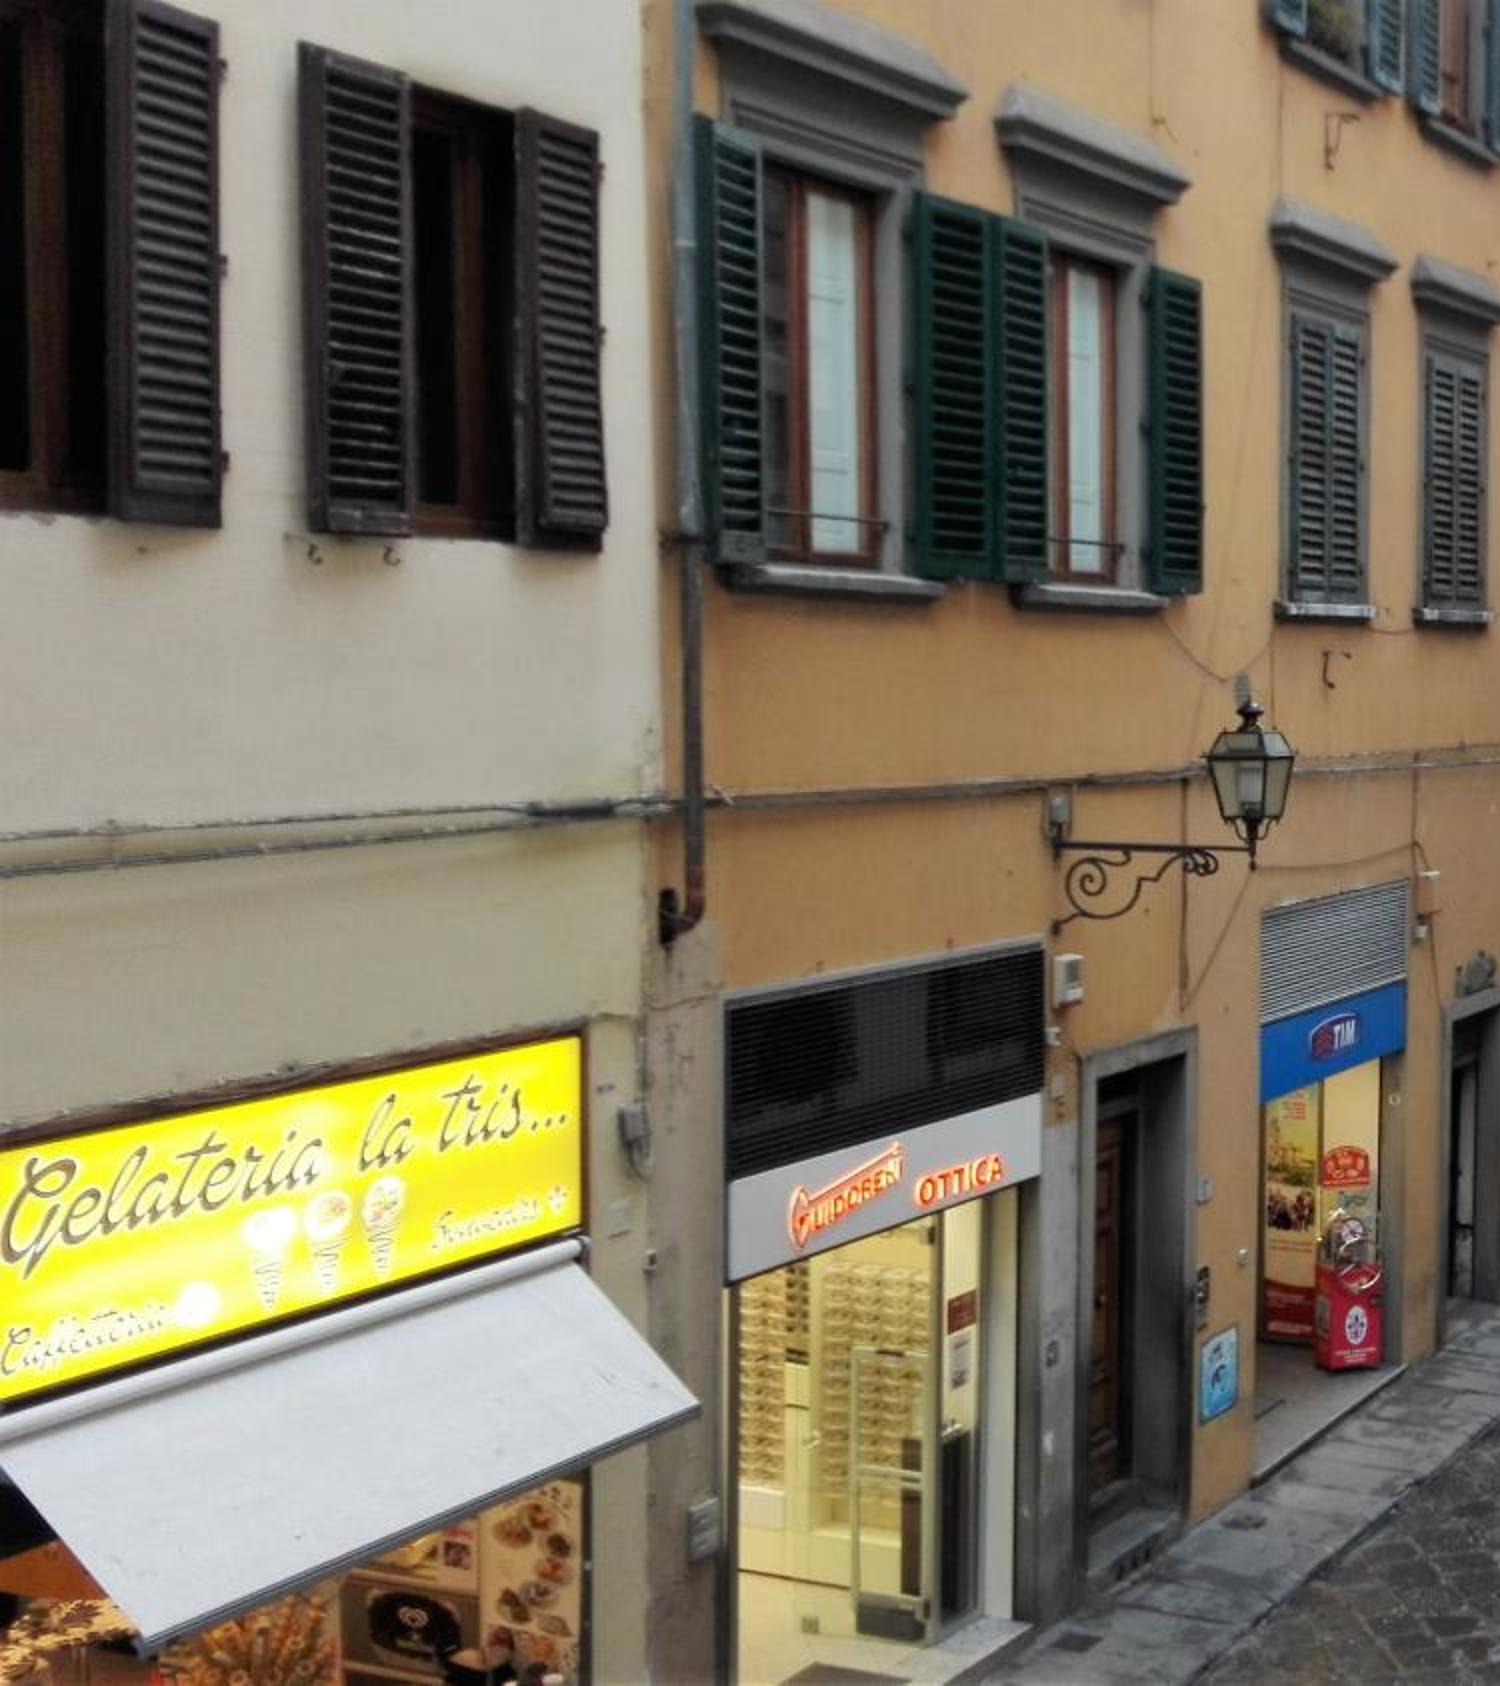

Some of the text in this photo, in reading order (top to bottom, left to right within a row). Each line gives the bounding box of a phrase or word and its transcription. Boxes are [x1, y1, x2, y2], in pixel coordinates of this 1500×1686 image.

[1333, 1018, 1356, 1049] TIM
[1, 1131, 323, 1281] Gelateria
[358, 1093, 414, 1172] la
[914, 1152, 1004, 1208] OTTICA
